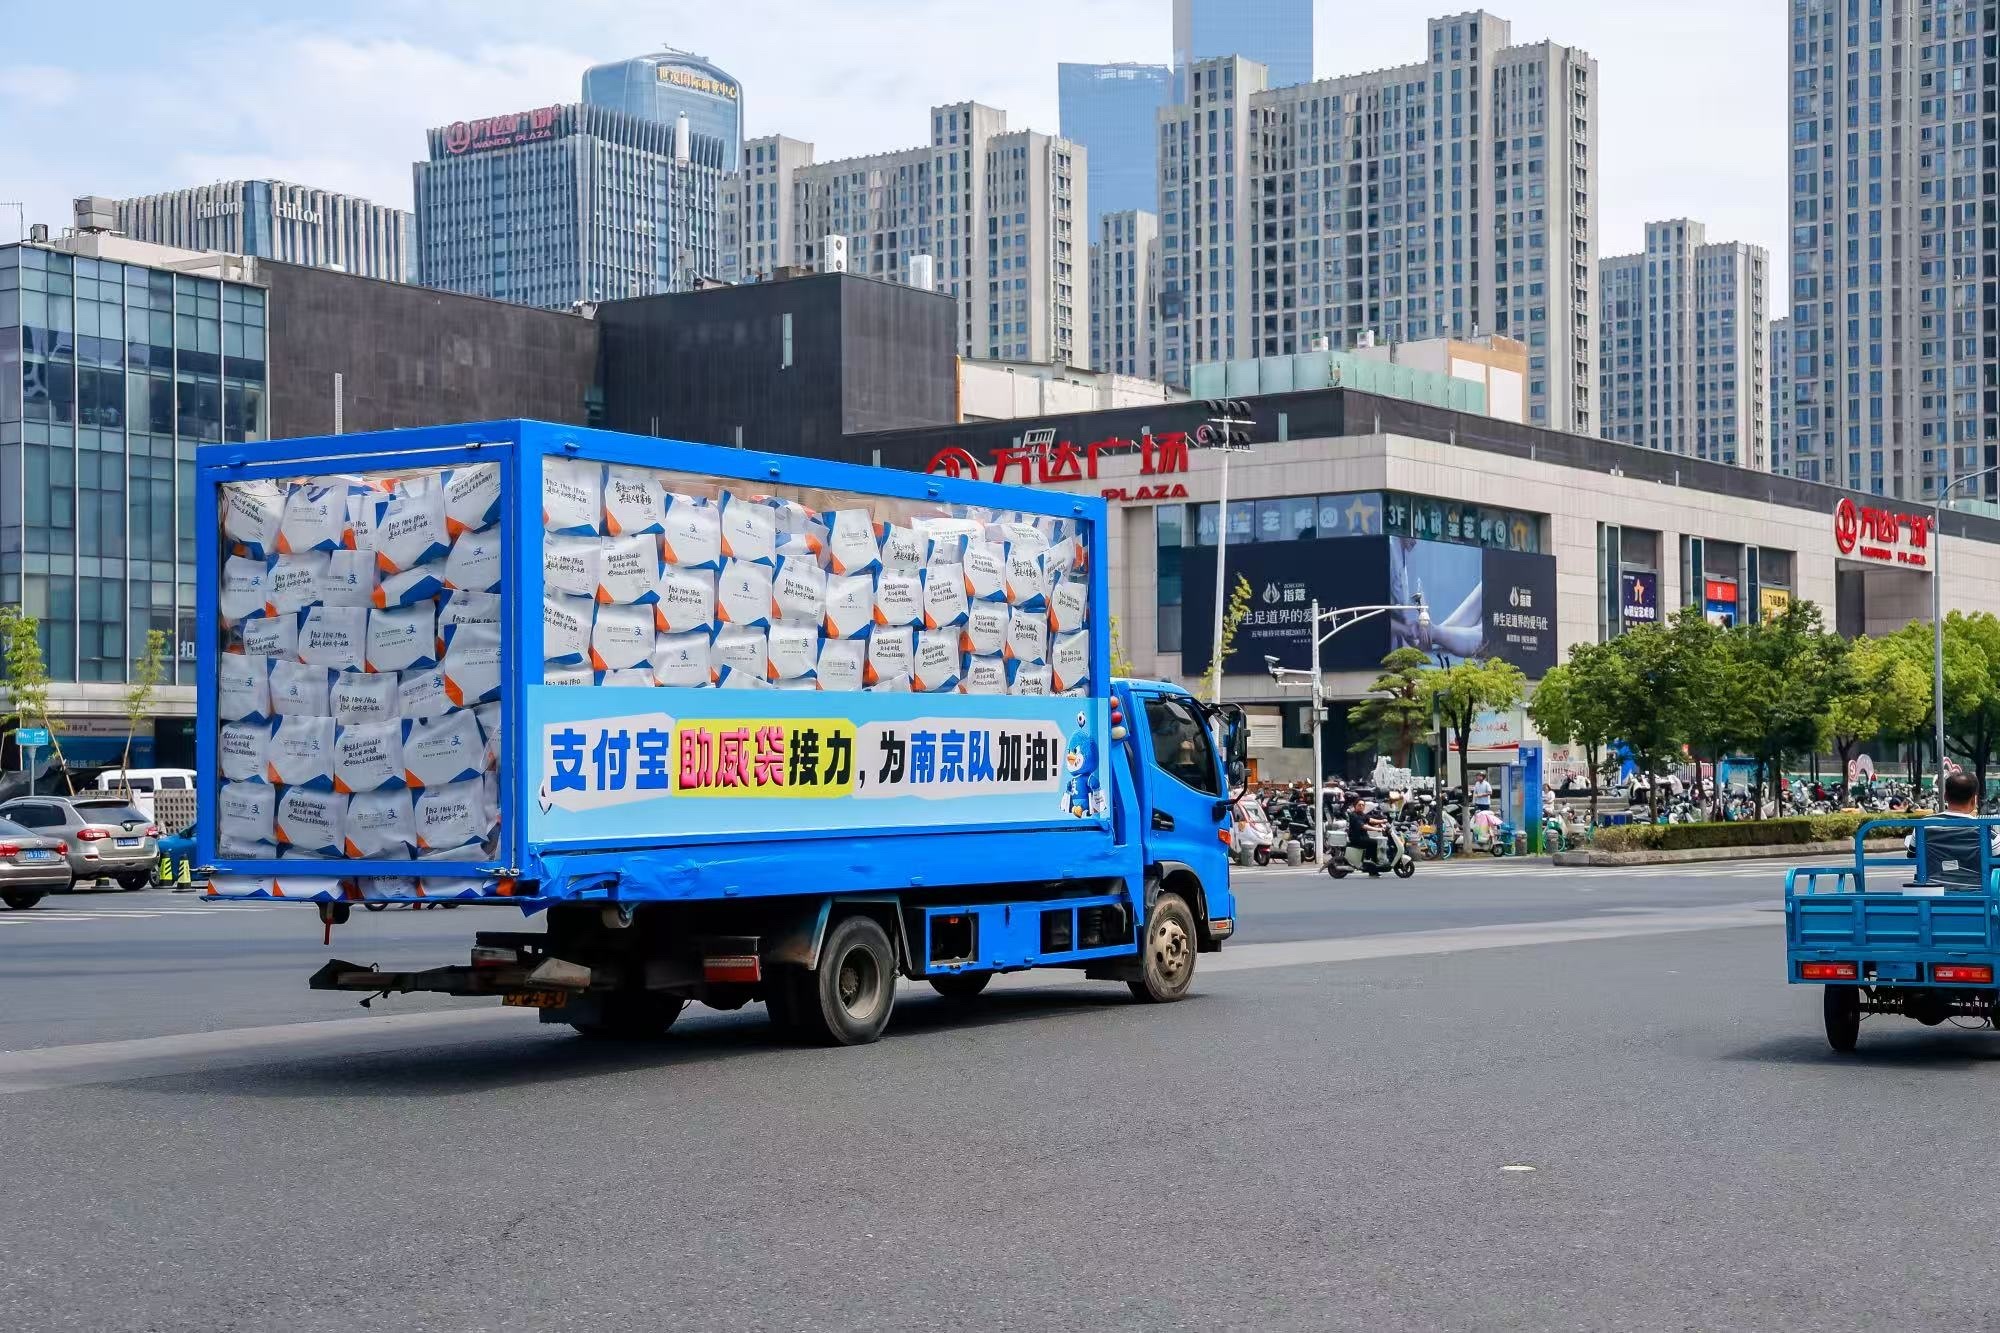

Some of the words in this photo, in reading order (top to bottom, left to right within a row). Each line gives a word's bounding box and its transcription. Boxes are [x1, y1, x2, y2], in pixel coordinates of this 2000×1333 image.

[473, 137, 512, 149] WANDA
[515, 129, 552, 143] PLAZA
[197, 201, 239, 220] Hilton
[276, 201, 322, 224] Hilton
[990, 431, 1189, 484] 万达广场
[1101, 483, 1189, 500] PLAZA
[1388, 504, 1406, 526] 3F
